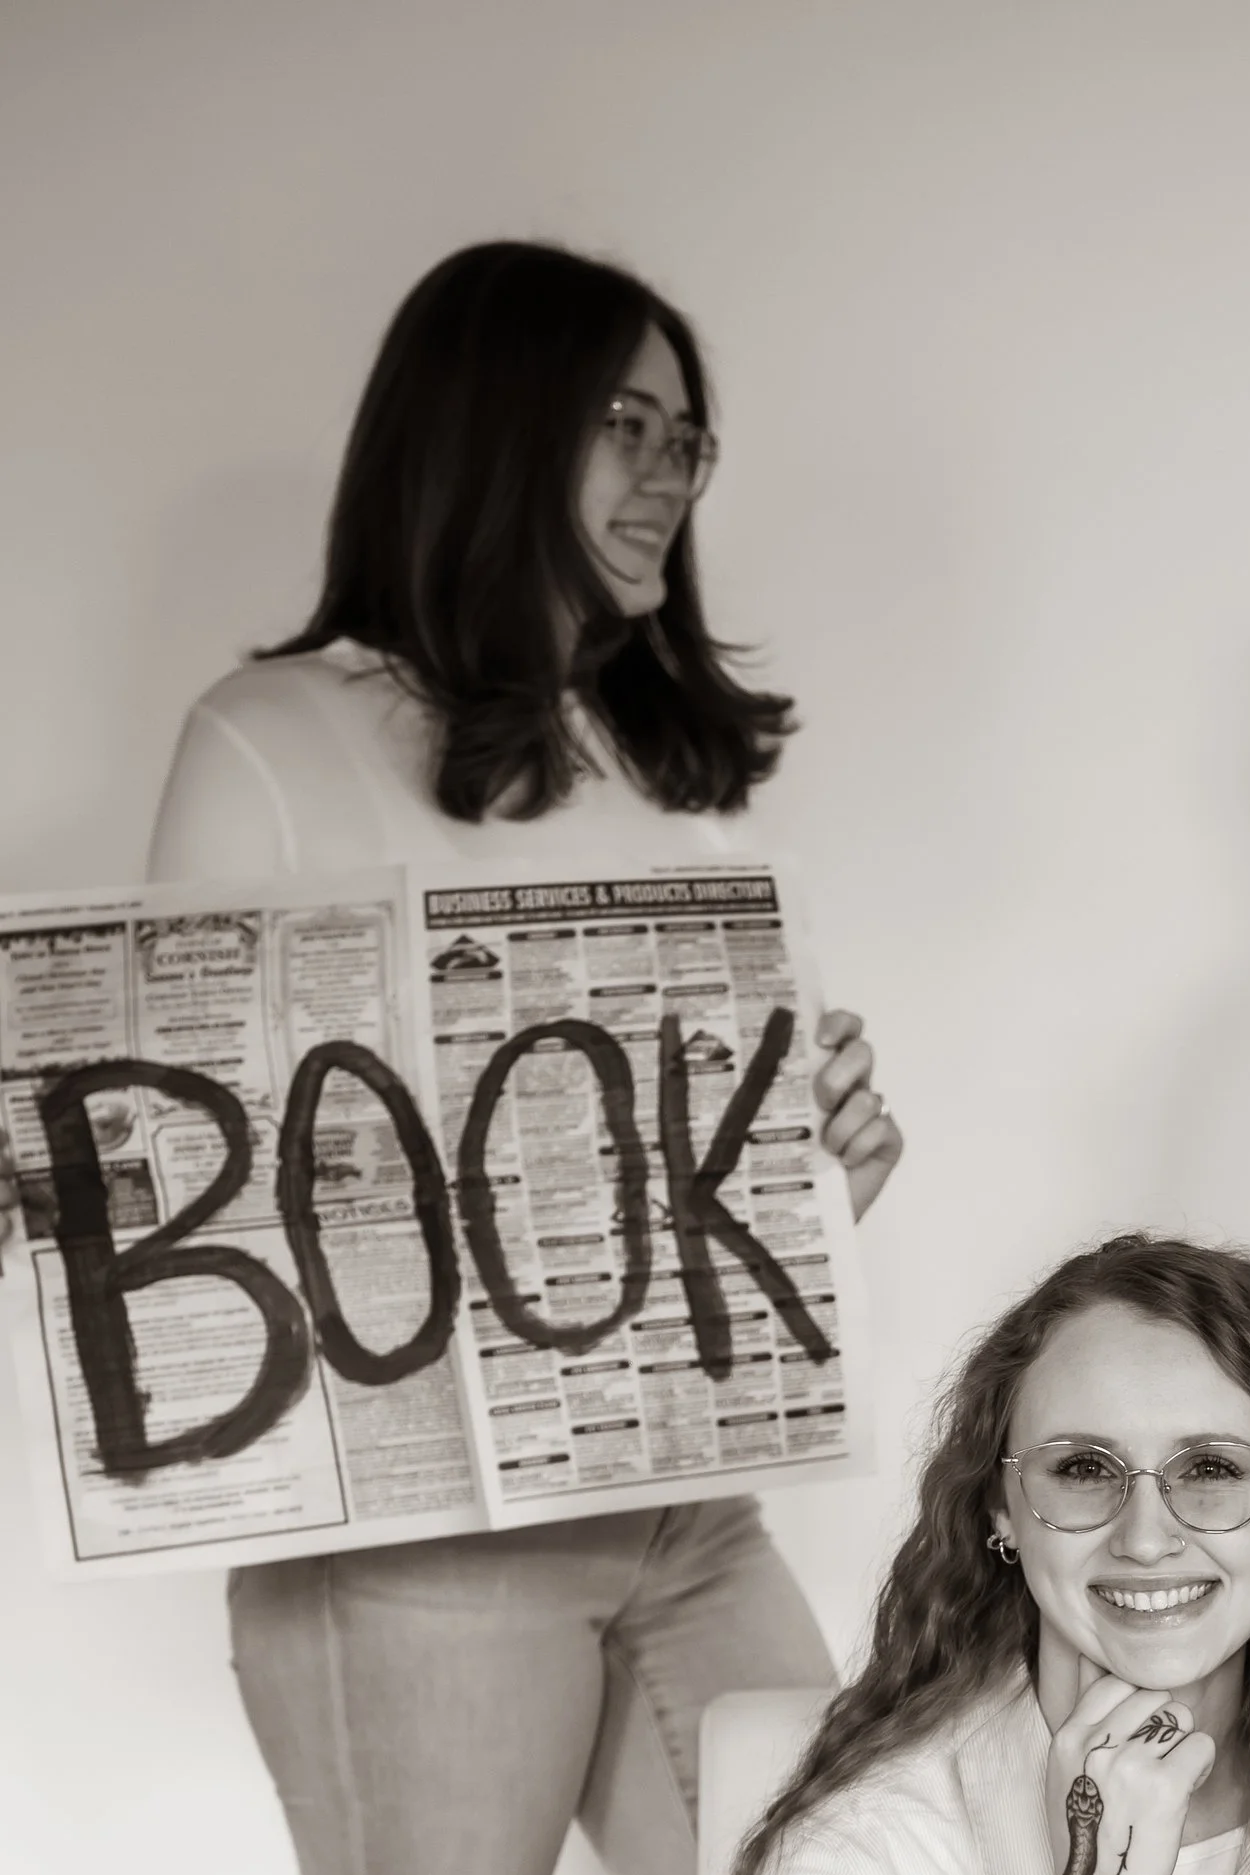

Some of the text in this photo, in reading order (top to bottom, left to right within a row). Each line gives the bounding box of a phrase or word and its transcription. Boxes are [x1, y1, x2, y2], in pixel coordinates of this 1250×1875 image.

[429, 891, 512, 916] BUSINESS
[515, 886, 592, 910] SERVICES
[595, 885, 610, 904] &
[36, 1006, 842, 1484] BOOK
